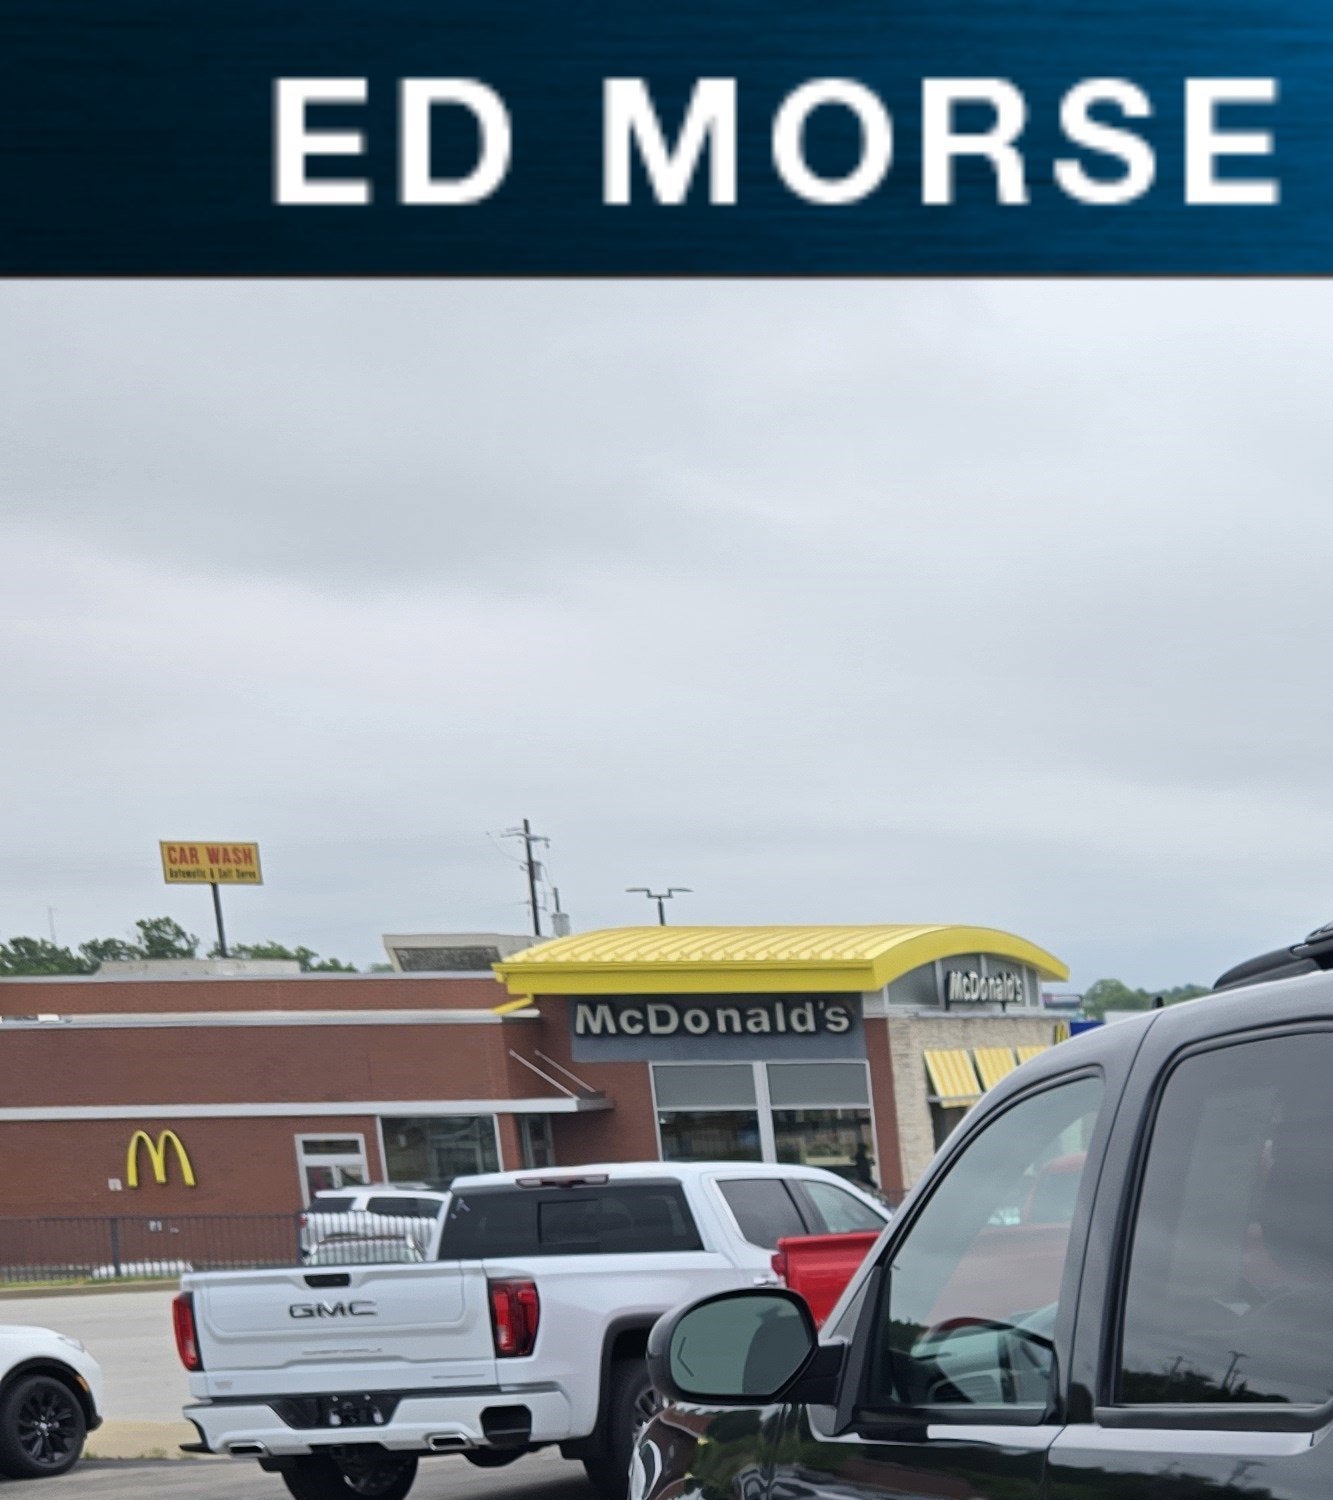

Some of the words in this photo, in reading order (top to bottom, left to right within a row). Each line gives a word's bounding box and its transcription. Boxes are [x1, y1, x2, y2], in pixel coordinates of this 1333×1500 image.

[167, 846, 200, 865] CAR
[205, 846, 253, 865] WASH
[948, 970, 1023, 1001] McDonald's
[574, 1001, 851, 1035] McDonald's
[288, 1300, 378, 1320] GMC
